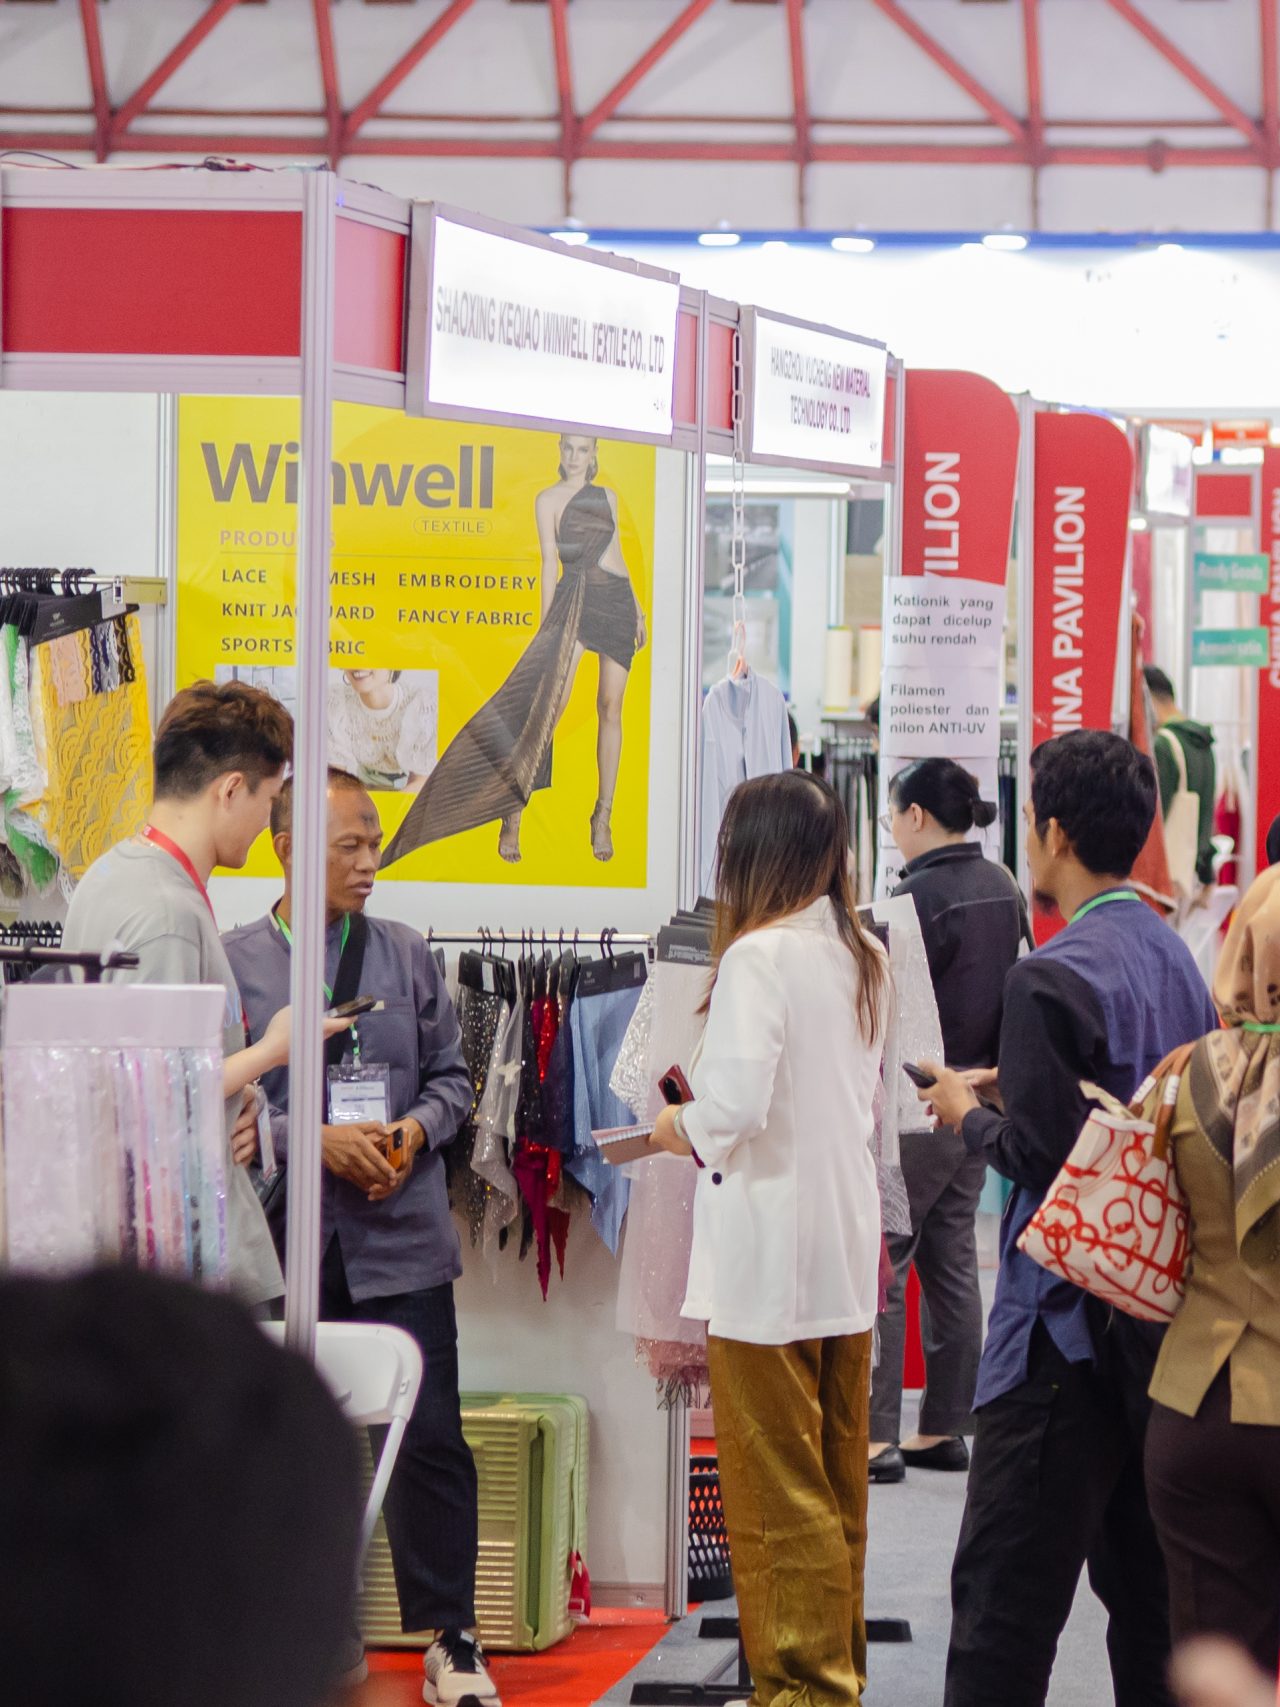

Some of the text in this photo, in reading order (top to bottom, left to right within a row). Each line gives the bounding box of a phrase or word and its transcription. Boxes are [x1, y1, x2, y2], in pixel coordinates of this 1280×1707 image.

[436, 285, 496, 343] SHAOXING
[498, 301, 541, 352] KEQIAO
[543, 312, 588, 361] WINWELL
[592, 321, 627, 368] TEXTILE
[648, 334, 665, 374] LTD
[770, 347, 803, 382] HANGZHOU
[832, 362, 845, 393] NEW
[846, 365, 871, 399] MATERIAL
[791, 395, 828, 429] TECHNOLOGY
[924, 451, 961, 578] ILION
[421, 519, 486, 534] TEXTILE
[219, 529, 336, 549] PRODUS
[221, 568, 267, 584] LACE
[398, 573, 537, 591] EMBROIDERY
[893, 594, 994, 611] Kationik yang
[222, 603, 375, 620] KNIT JAARD
[398, 609, 534, 626] FANCY FABRIC
[1051, 486, 1086, 740] INA PAVILION
[893, 614, 992, 628] dapat dicelup
[221, 638, 293, 653] SPORTS
[892, 633, 977, 645] suhu rendah
[891, 684, 945, 696] Filamen
[890, 704, 990, 716] poliester dan
[890, 721, 986, 734] nilon ANTI-UV
